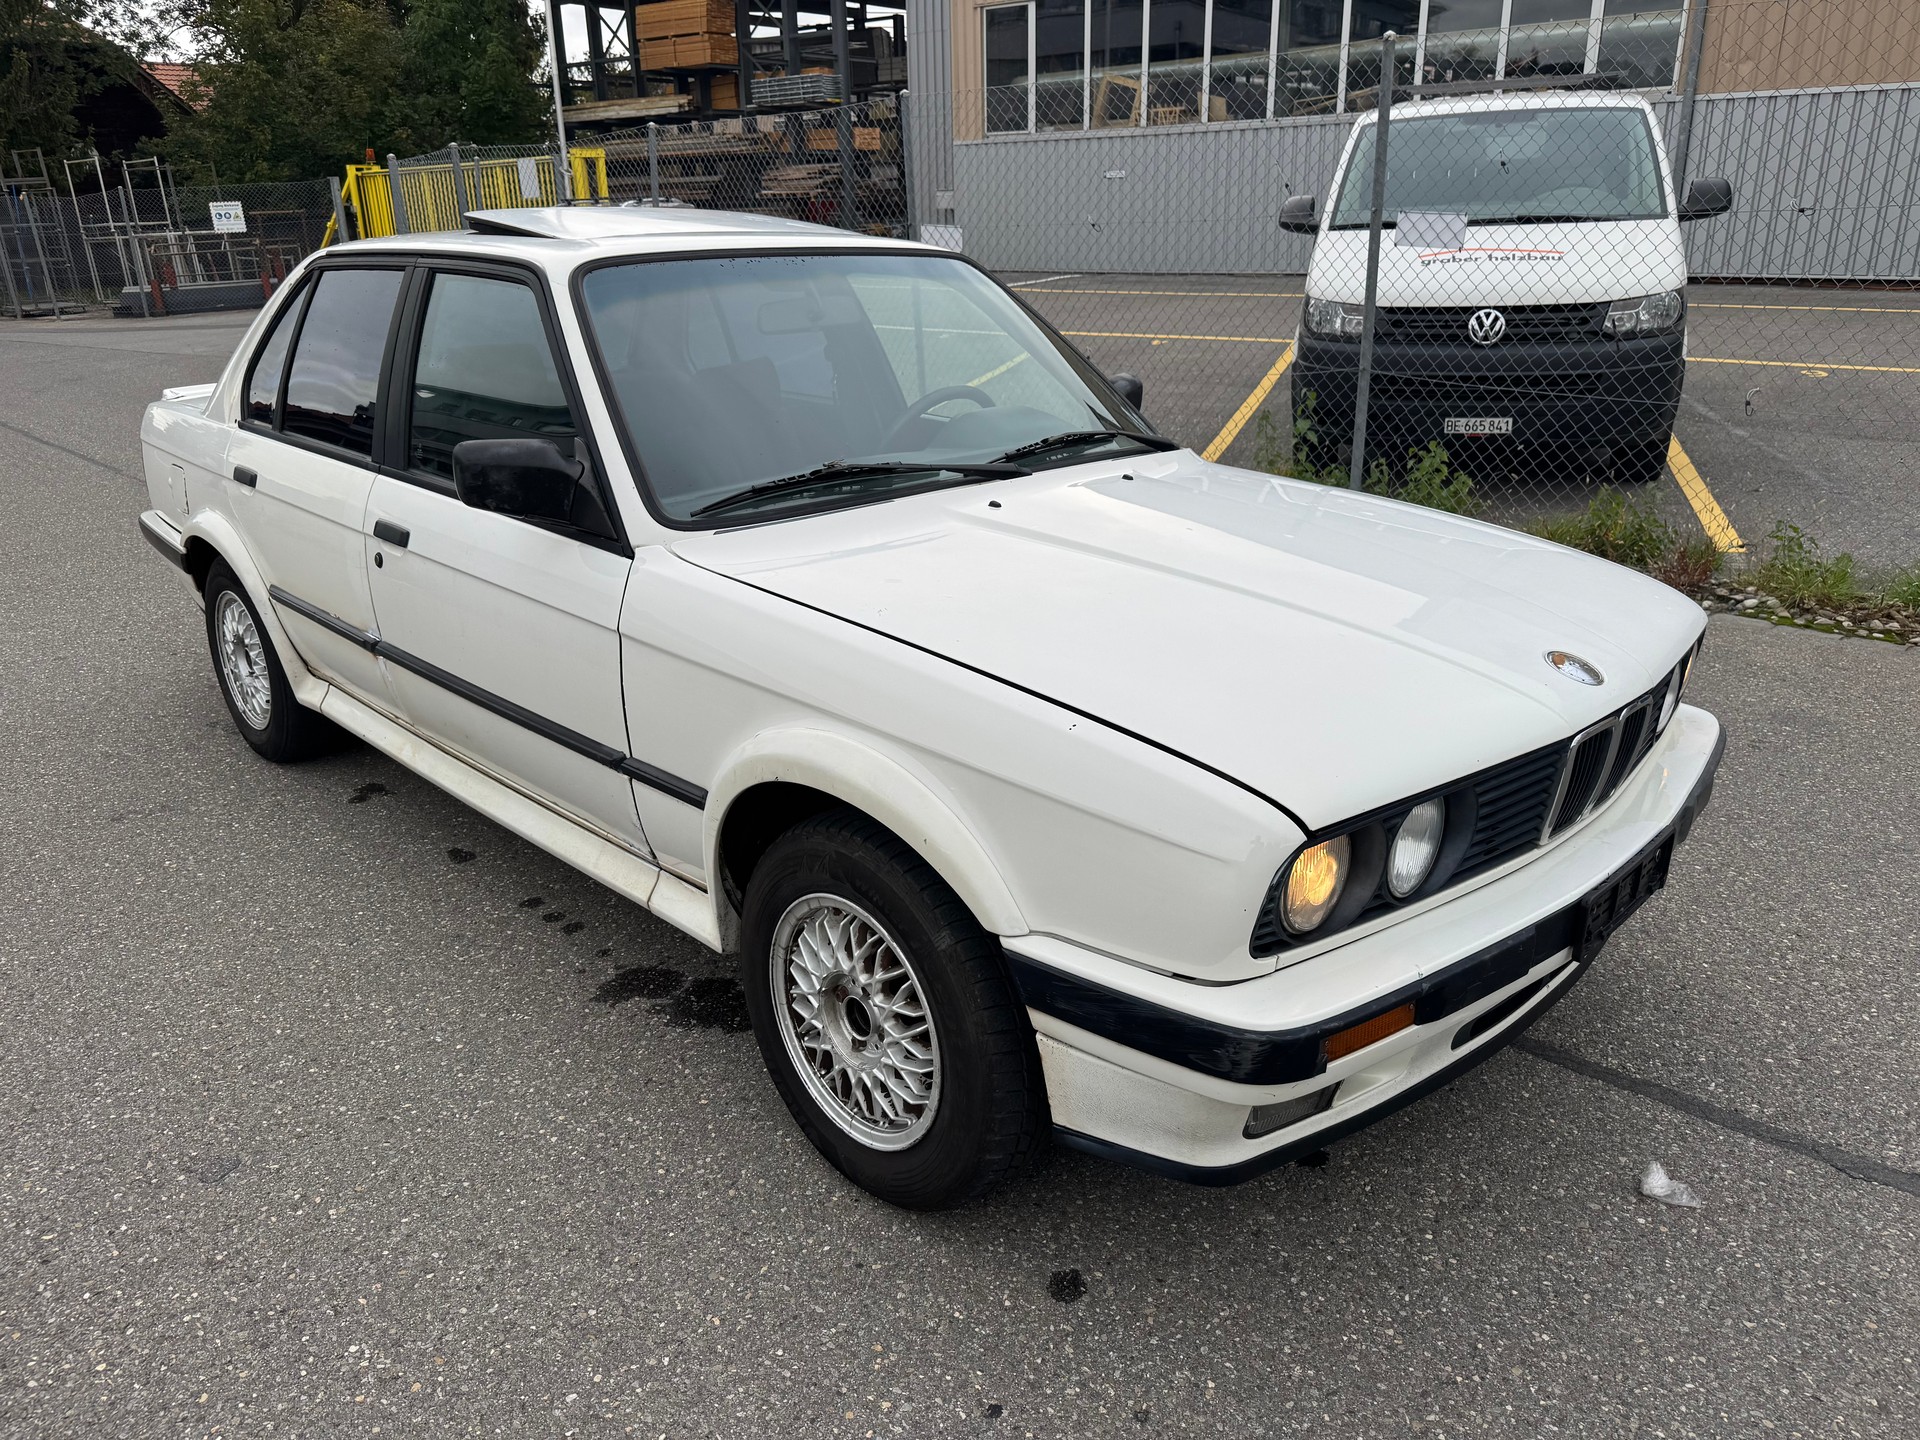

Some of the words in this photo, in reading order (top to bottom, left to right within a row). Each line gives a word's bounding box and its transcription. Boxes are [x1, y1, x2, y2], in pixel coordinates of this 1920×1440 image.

[1421, 254, 1482, 266] graber
[1488, 253, 1563, 262] holzbau
[1468, 309, 1506, 344] VW
